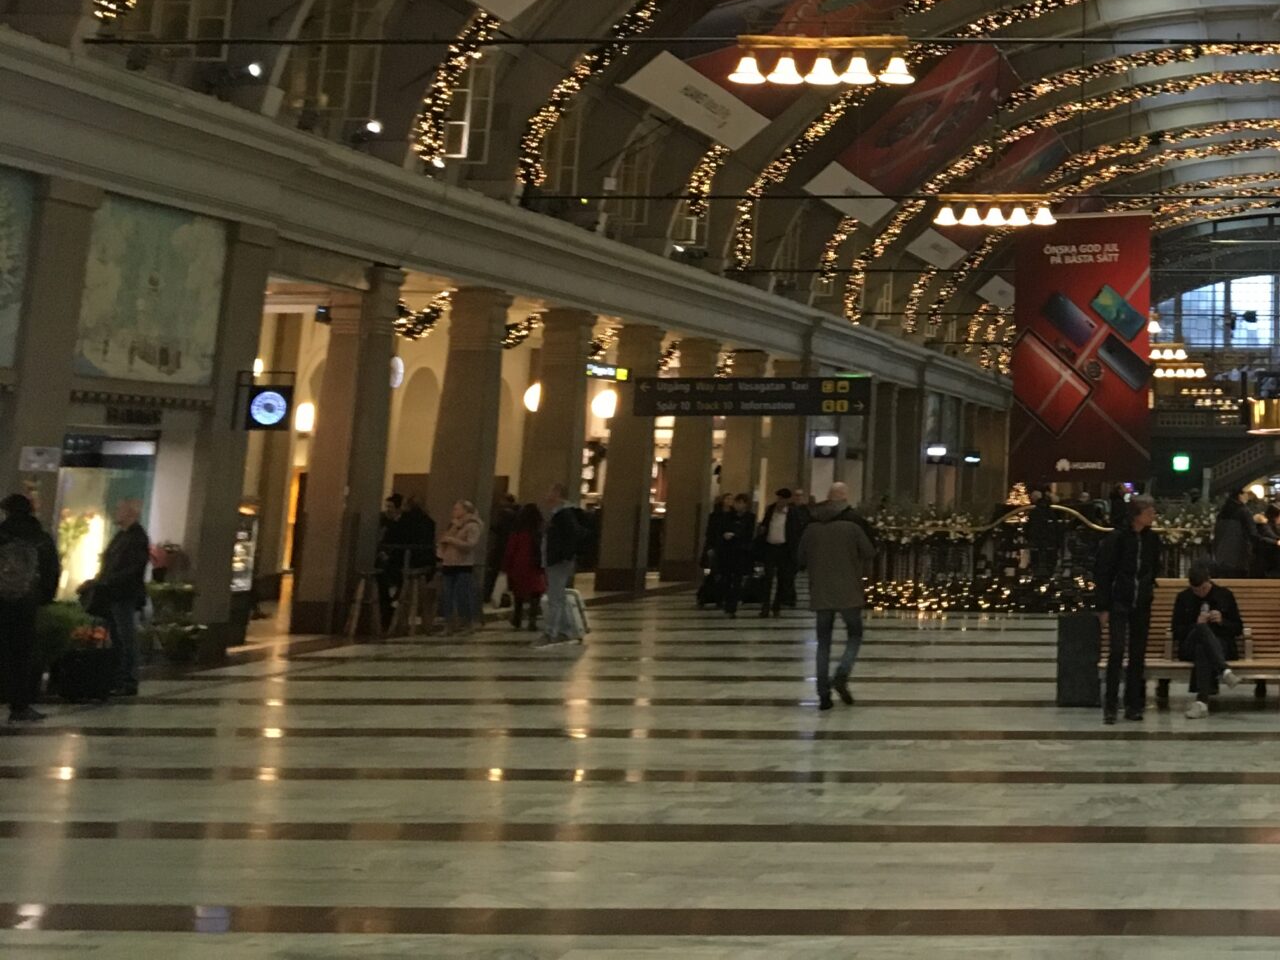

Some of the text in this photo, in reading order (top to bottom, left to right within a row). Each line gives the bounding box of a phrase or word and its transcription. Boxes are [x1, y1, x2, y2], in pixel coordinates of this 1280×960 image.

[1043, 243, 1120, 255] ÖNSKA GOD JUL
[1050, 251, 1120, 265] PÅ BÄSTA SÄTT
[656, 381, 691, 393] Utgång
[738, 380, 786, 393] Vasagatan
[791, 381, 809, 390] Taxi
[656, 400, 680, 412] Spår
[681, 401, 691, 410] 10
[740, 400, 796, 410] Information
